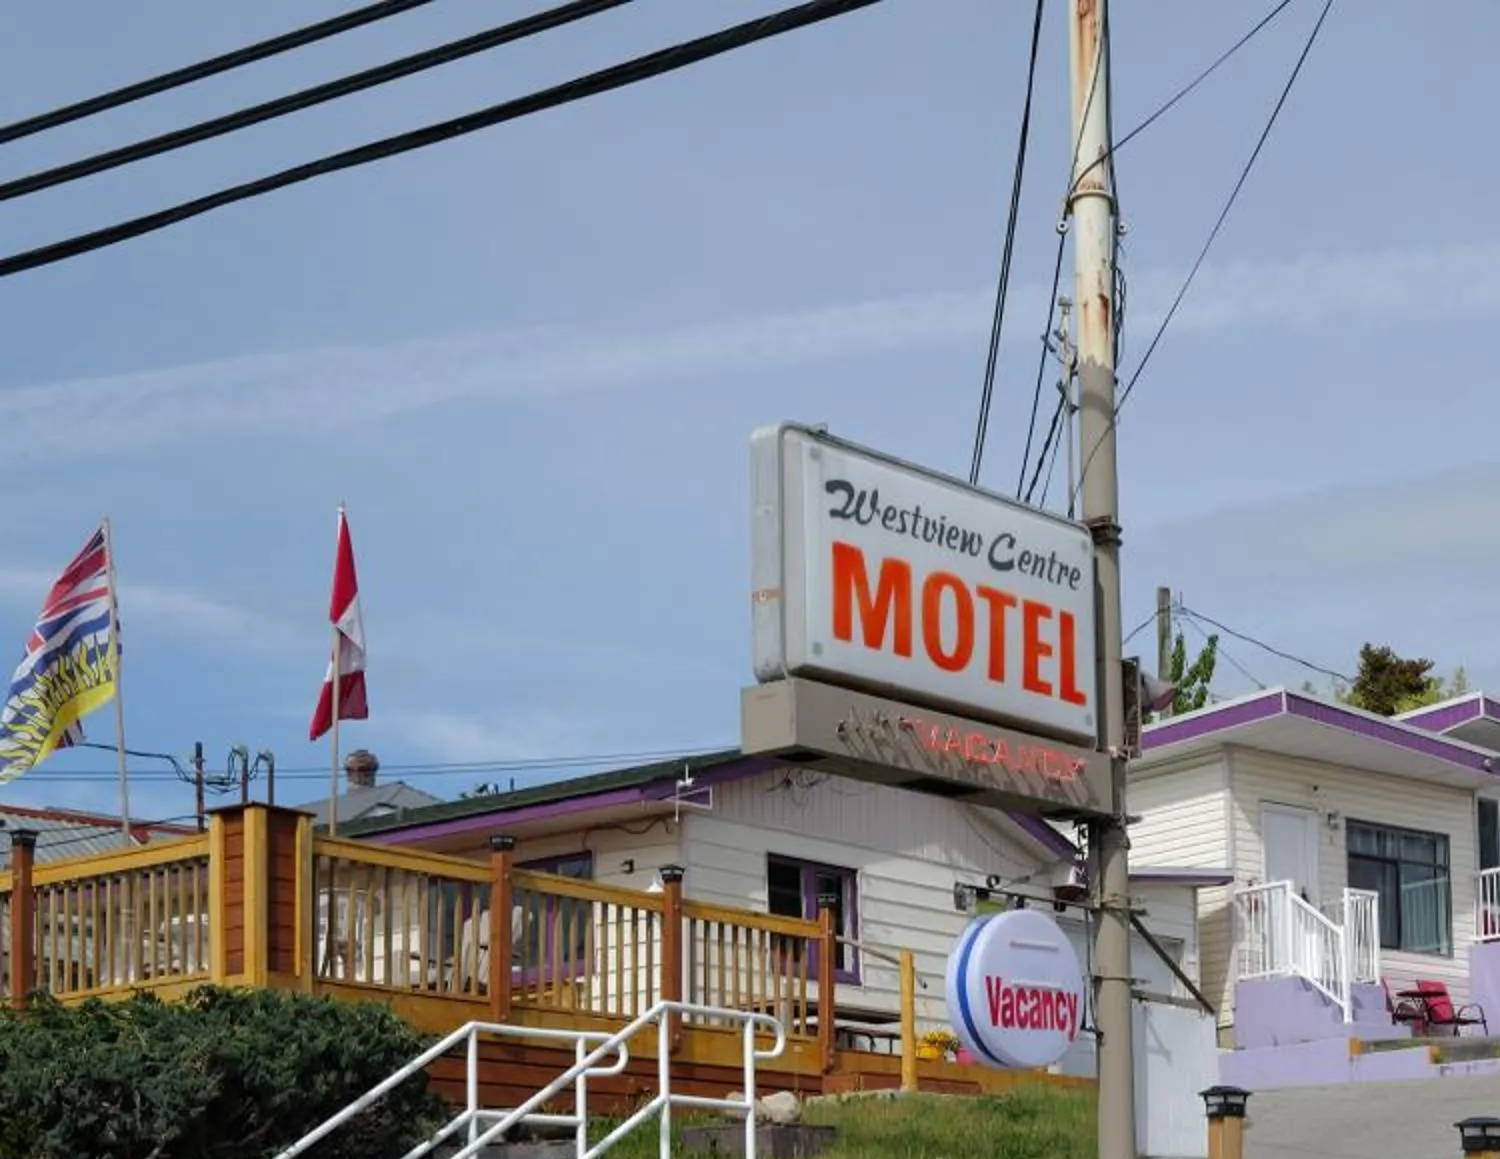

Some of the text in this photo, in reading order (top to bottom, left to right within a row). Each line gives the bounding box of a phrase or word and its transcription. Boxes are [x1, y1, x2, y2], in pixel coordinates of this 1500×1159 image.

[825, 479, 1081, 591] Westview Centre
[832, 540, 1087, 706] MOTEL
[985, 975, 1077, 1041] Vacancy
